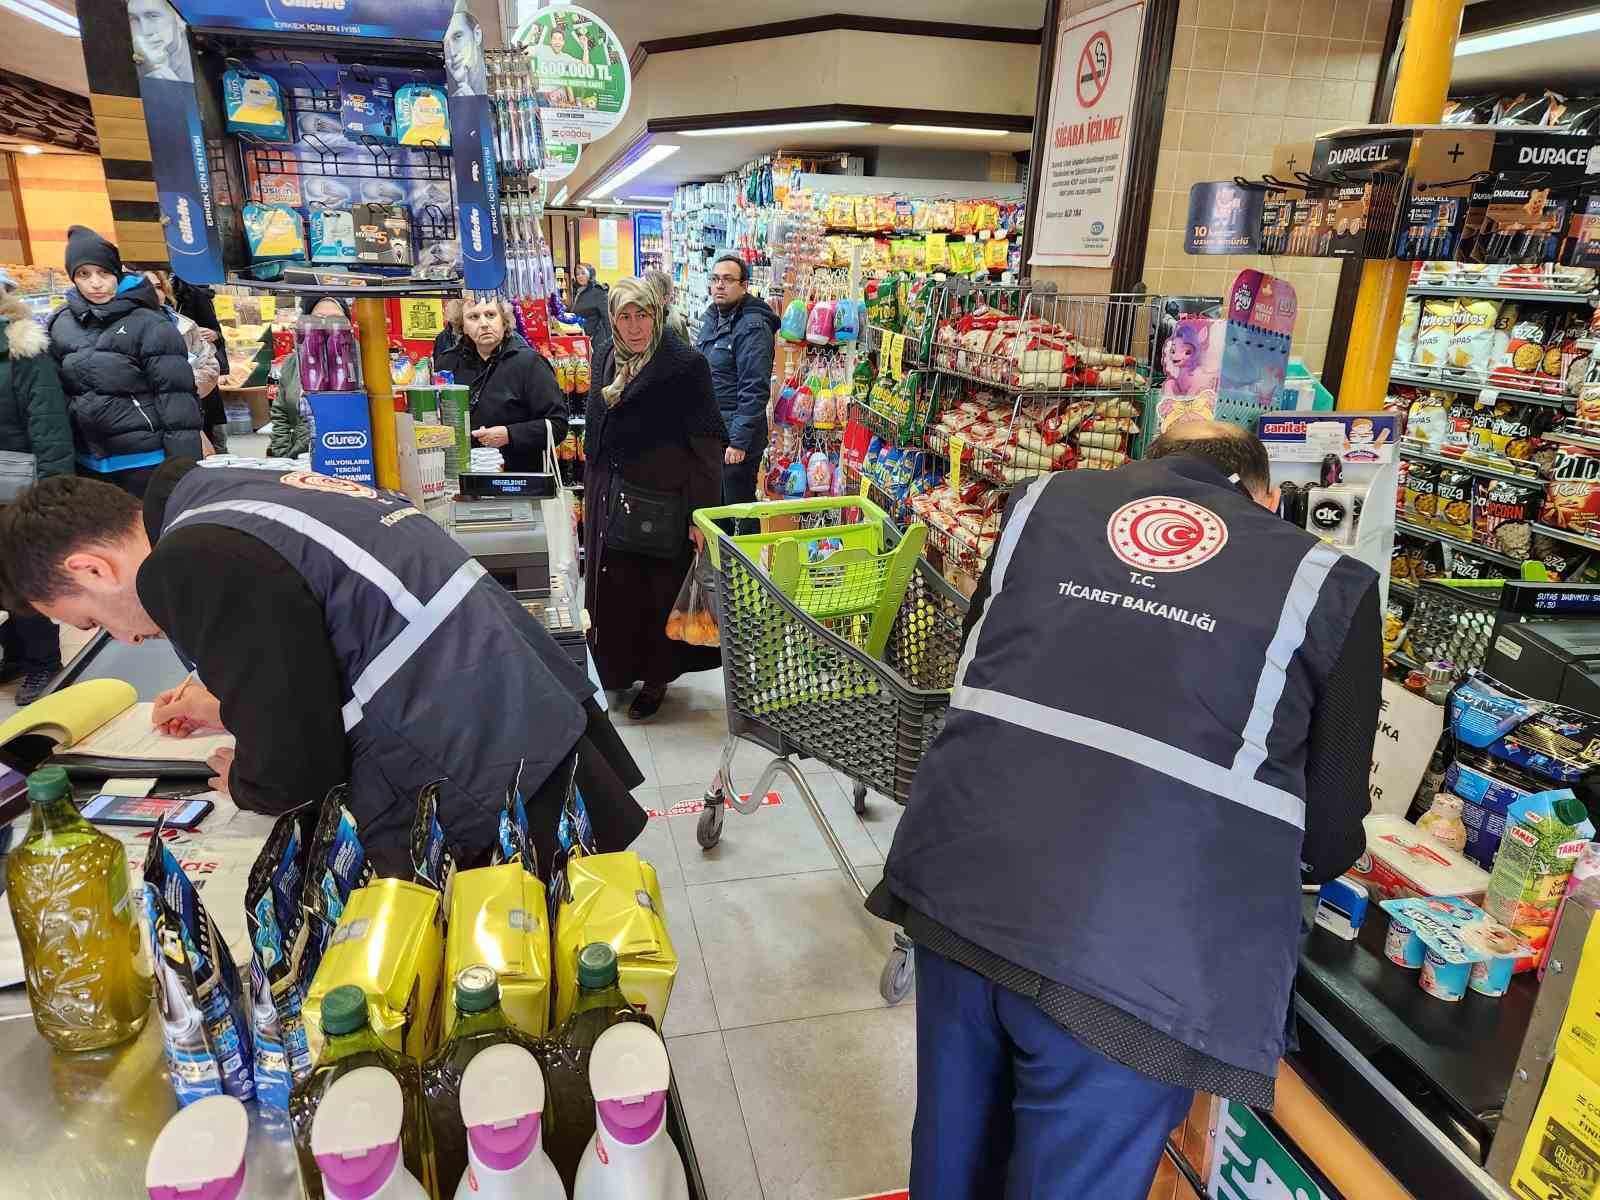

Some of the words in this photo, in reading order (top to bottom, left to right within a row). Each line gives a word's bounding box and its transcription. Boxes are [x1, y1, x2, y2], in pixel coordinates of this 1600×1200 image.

[1327, 145, 1389, 165] DURACELL
[326, 433, 363, 446] durex
[1129, 571, 1156, 588] T.C.
[1058, 580, 1122, 606] TİCARET
[1122, 595, 1217, 632] BAKANLIĞI
